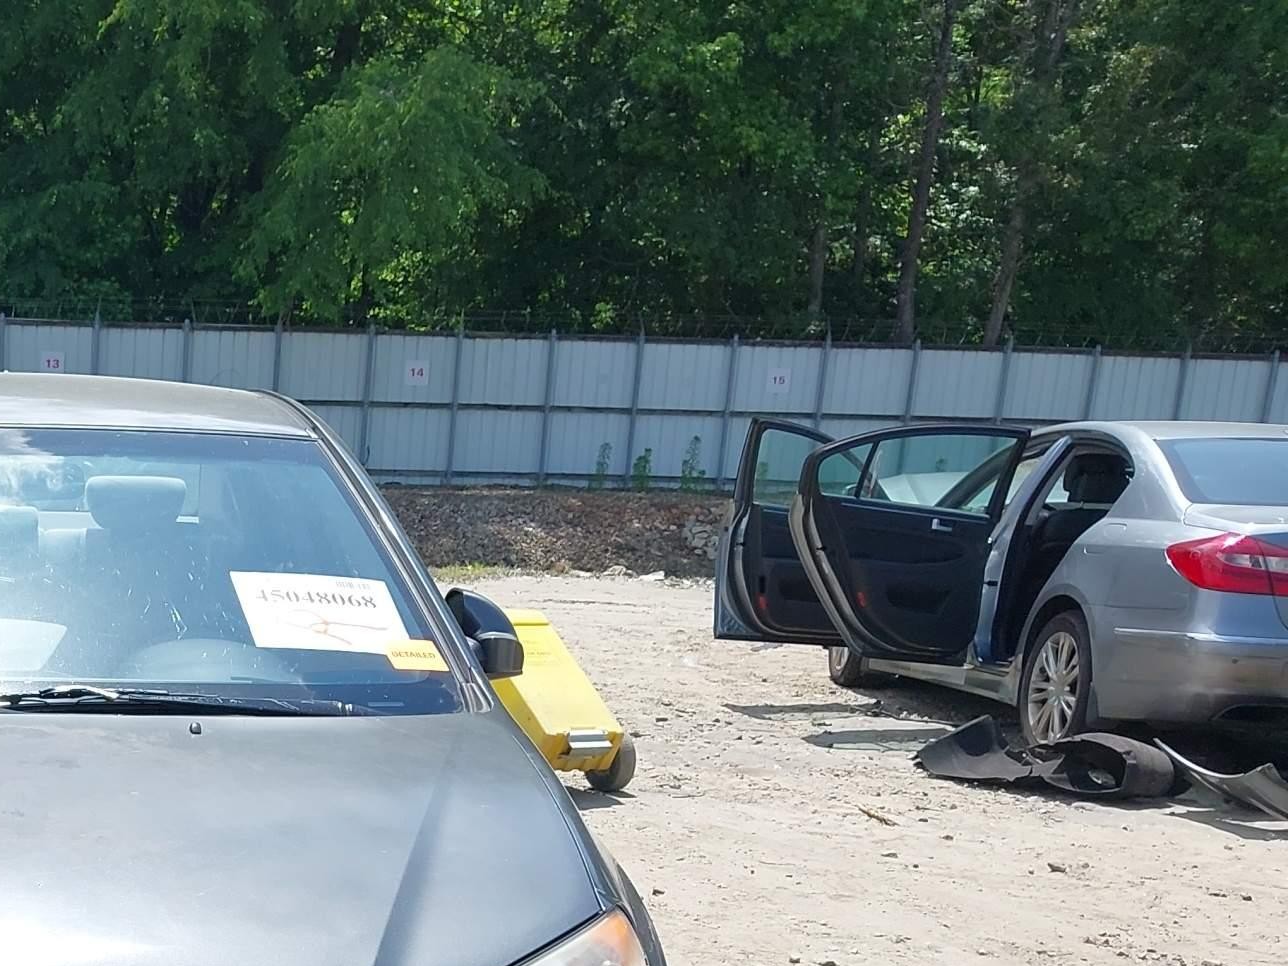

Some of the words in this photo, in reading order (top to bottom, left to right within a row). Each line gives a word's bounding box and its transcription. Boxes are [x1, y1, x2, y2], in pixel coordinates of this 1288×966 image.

[46, 359, 60, 369] 13
[411, 367, 424, 377] 14
[256, 588, 377, 609] 45048068
